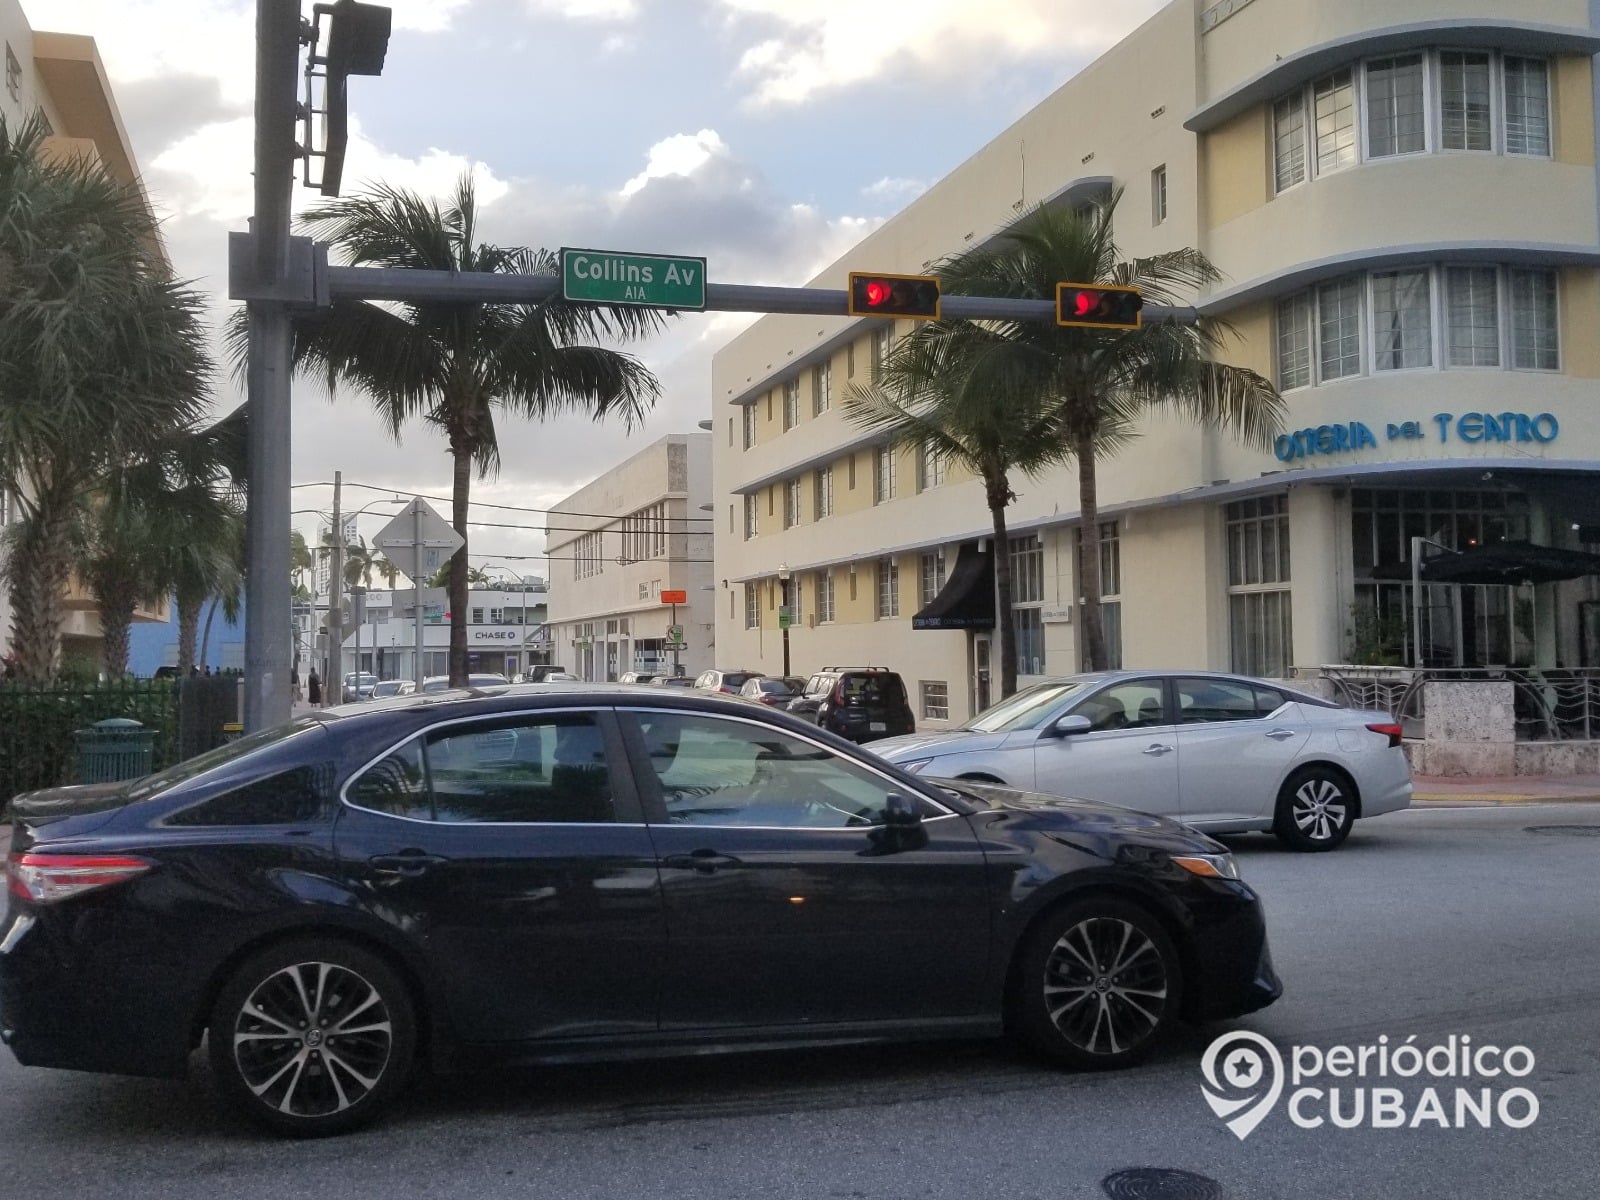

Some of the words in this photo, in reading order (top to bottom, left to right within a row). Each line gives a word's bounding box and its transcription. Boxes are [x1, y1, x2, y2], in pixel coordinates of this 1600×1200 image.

[573, 256, 654, 283] Collins
[663, 263, 695, 286] Av
[1275, 421, 1377, 462] OSTERIA
[1387, 421, 1425, 441] DEL
[1433, 412, 1559, 444] TEATRO
